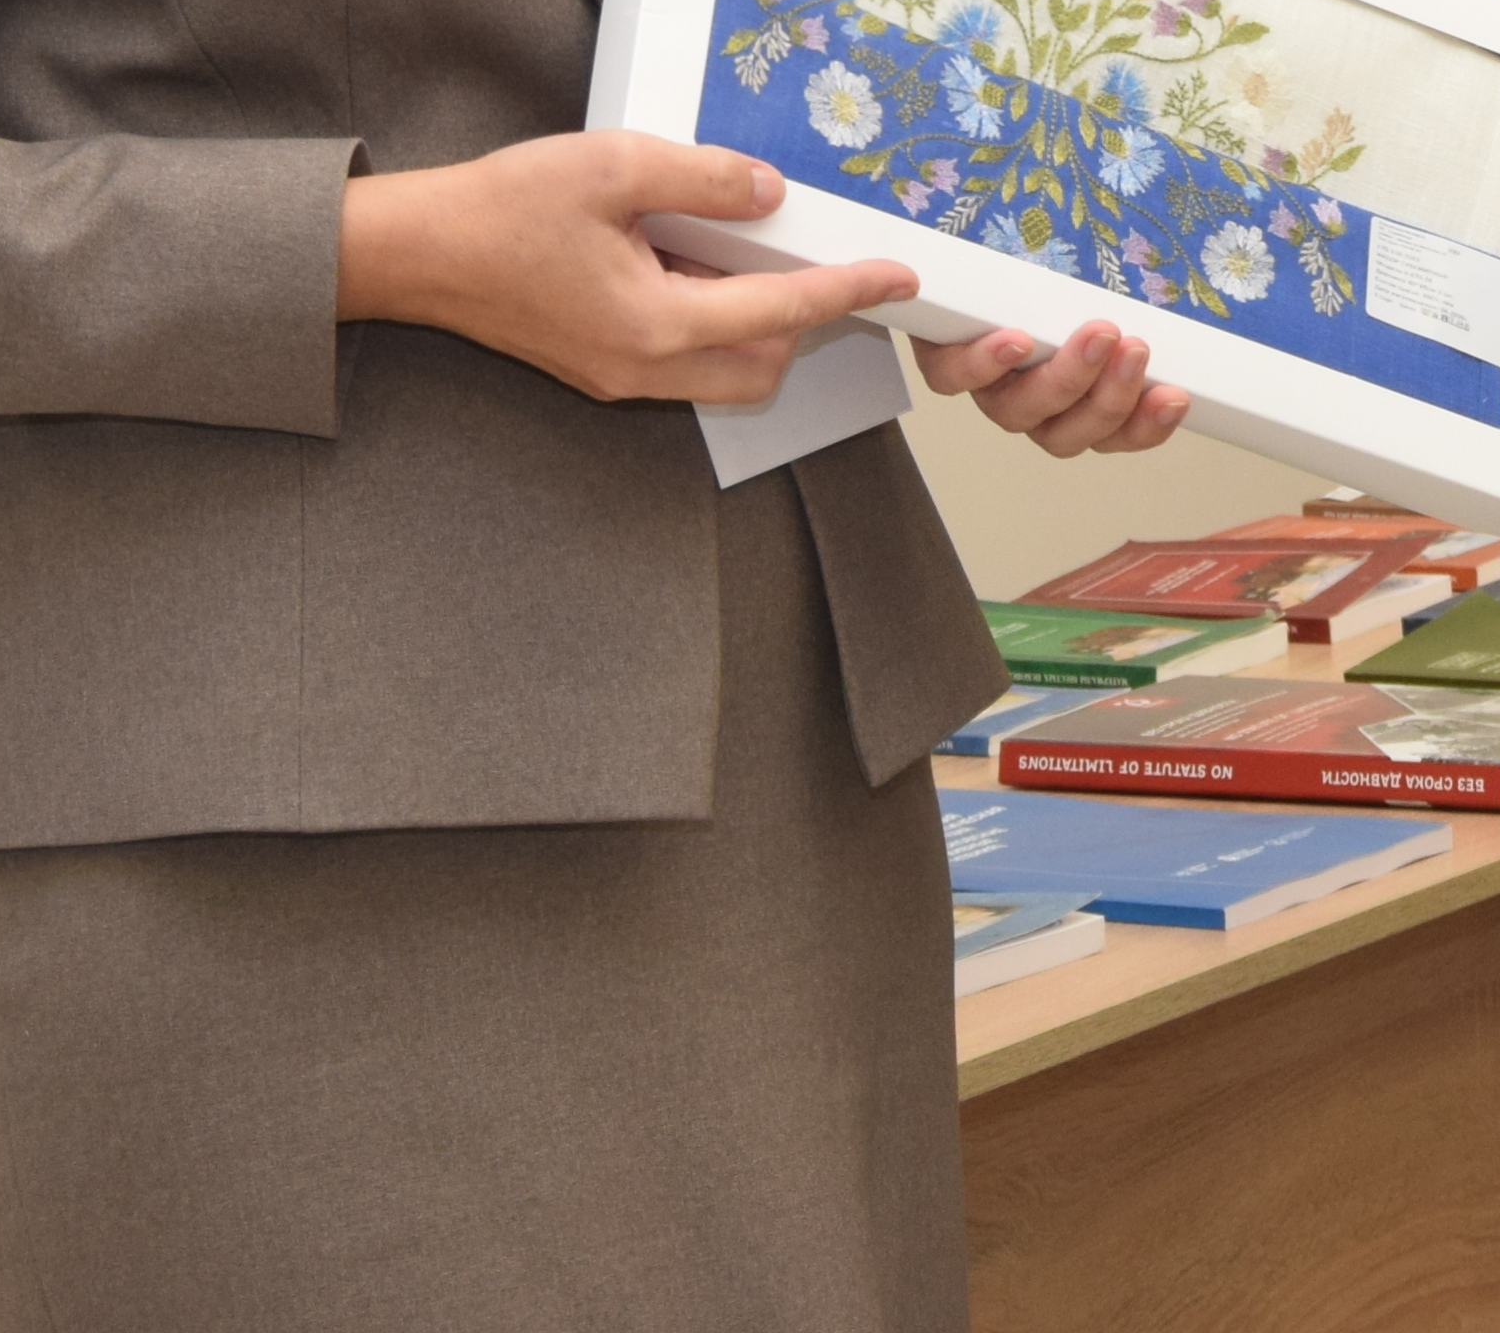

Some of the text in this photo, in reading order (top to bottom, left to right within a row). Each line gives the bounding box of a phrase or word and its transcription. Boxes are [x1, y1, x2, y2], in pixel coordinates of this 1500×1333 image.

[1017, 754, 1234, 780] NO STATUTE OF LIMITATIONS
[1321, 769, 1485, 794] БЕЗ СРОКА ДАВНОСТИ
